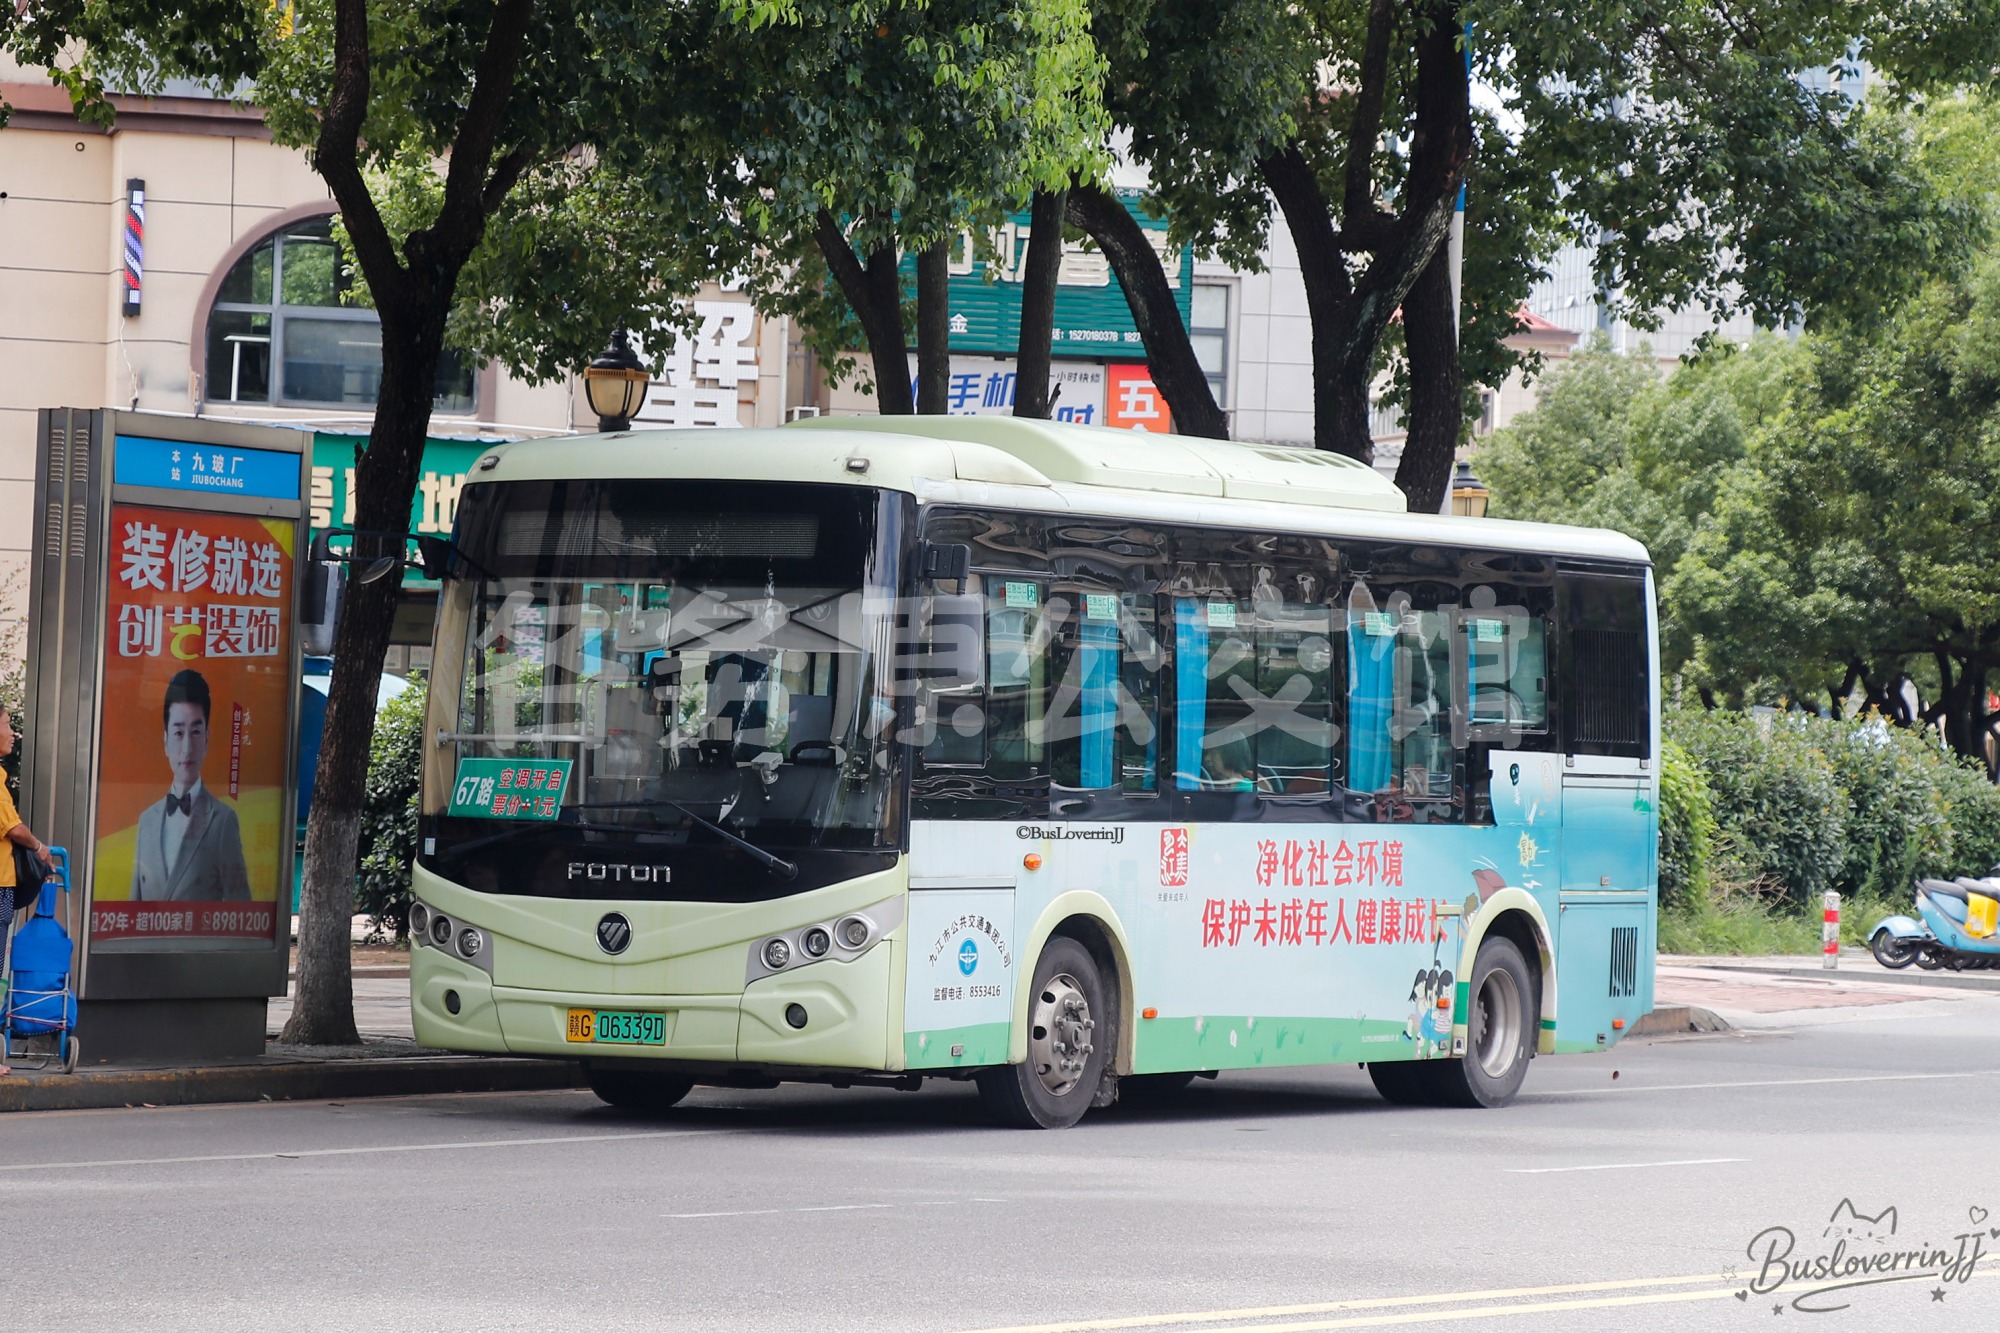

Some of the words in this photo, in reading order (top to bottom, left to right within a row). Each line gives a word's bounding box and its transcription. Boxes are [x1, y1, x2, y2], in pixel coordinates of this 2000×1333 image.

[192, 452, 244, 475] 九玻厂
[191, 474, 244, 488] JIUBOCHANG
[119, 521, 281, 598] 装修就选
[117, 604, 280, 660] 创艺装饰
[456, 776, 495, 806] 67路
[497, 768, 564, 790] 空调开启
[568, 862, 671, 882] FOTON
[1255, 838, 1404, 888] 净化社会环境
[212, 911, 271, 933] 8981200
[928, 914, 1012, 969] 九江市公共交通集团公司
